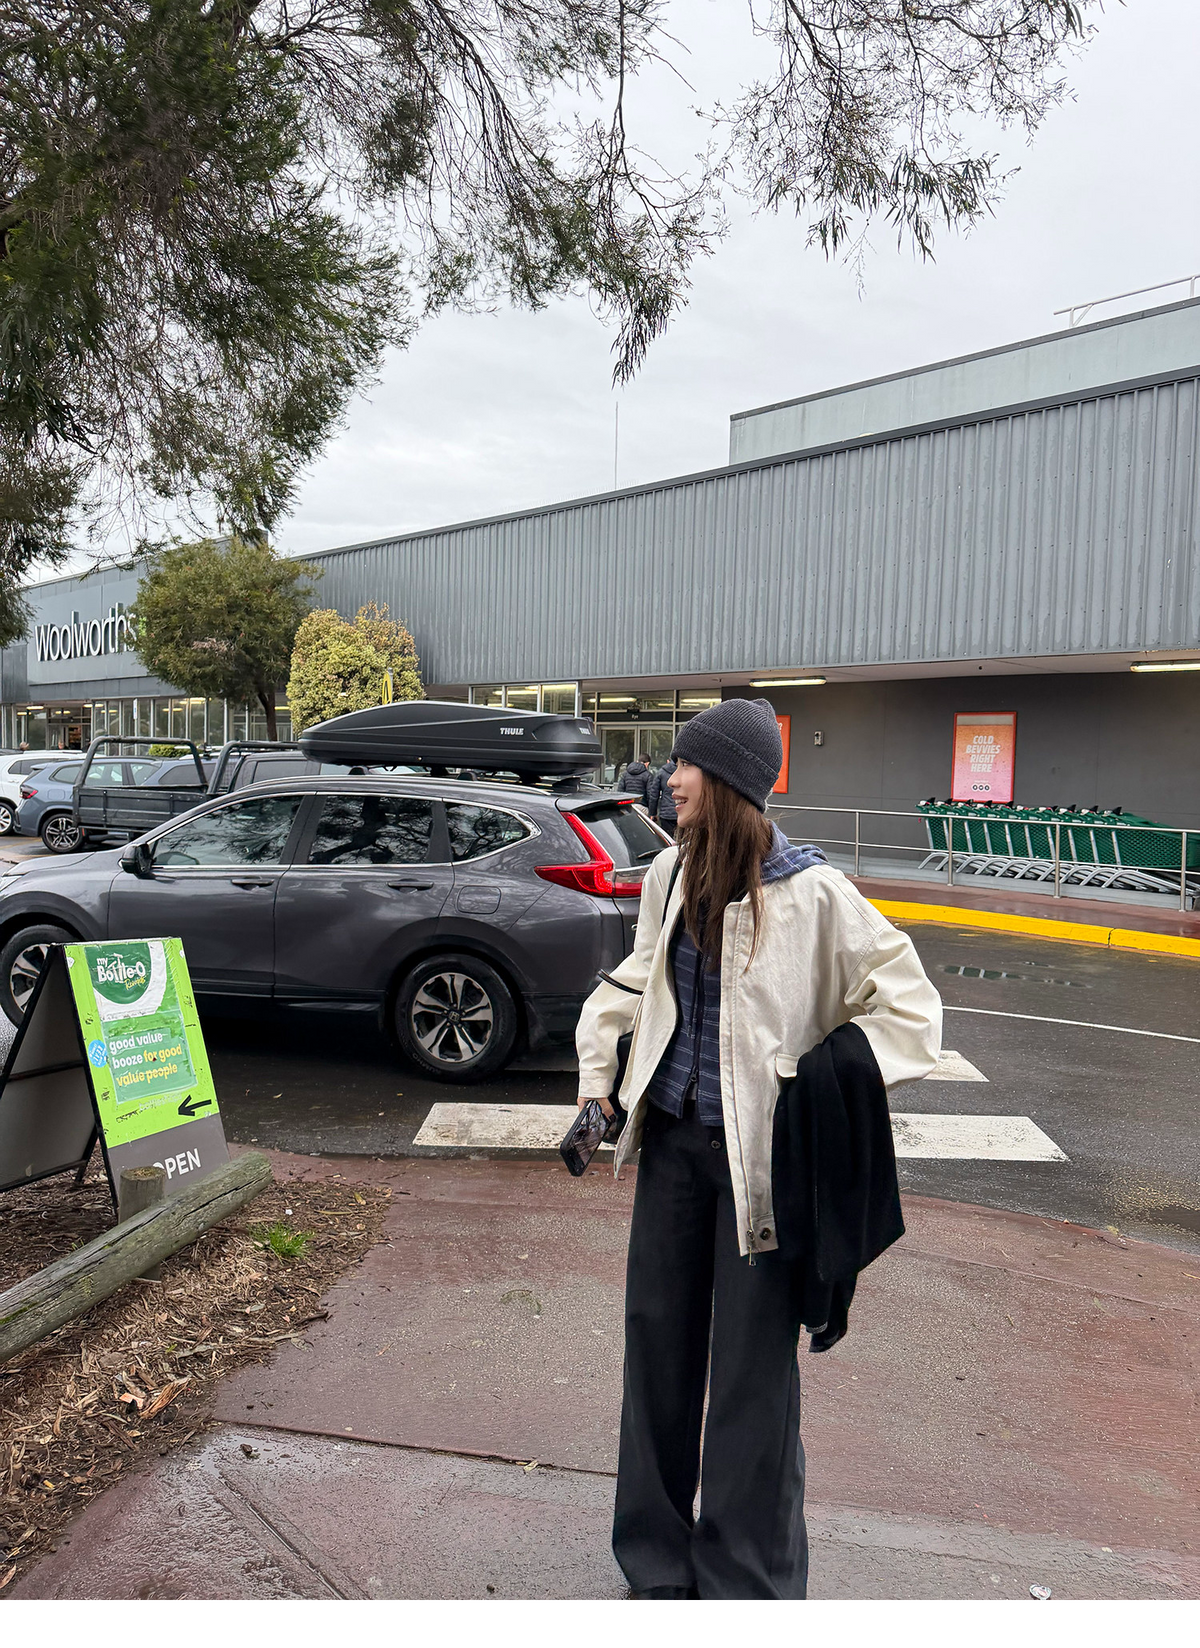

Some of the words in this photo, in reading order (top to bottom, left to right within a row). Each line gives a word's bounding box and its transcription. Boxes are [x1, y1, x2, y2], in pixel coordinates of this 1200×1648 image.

[35, 602, 137, 662] woolworths
[500, 727, 524, 736] THULE
[972, 735, 994, 745] COLD
[965, 745, 1001, 754] BEVVIES
[969, 754, 996, 763] RIGHT
[970, 763, 993, 773] HERE
[96, 957, 109, 967] my
[109, 1035, 135, 1055] good
[136, 1032, 163, 1046] value
[112, 1054, 143, 1069] booze
[143, 1049, 158, 1062] for
[158, 1044, 182, 1062] good
[116, 1071, 145, 1087] value
[146, 1063, 178, 1083] people
[152, 1148, 201, 1180] PEN
